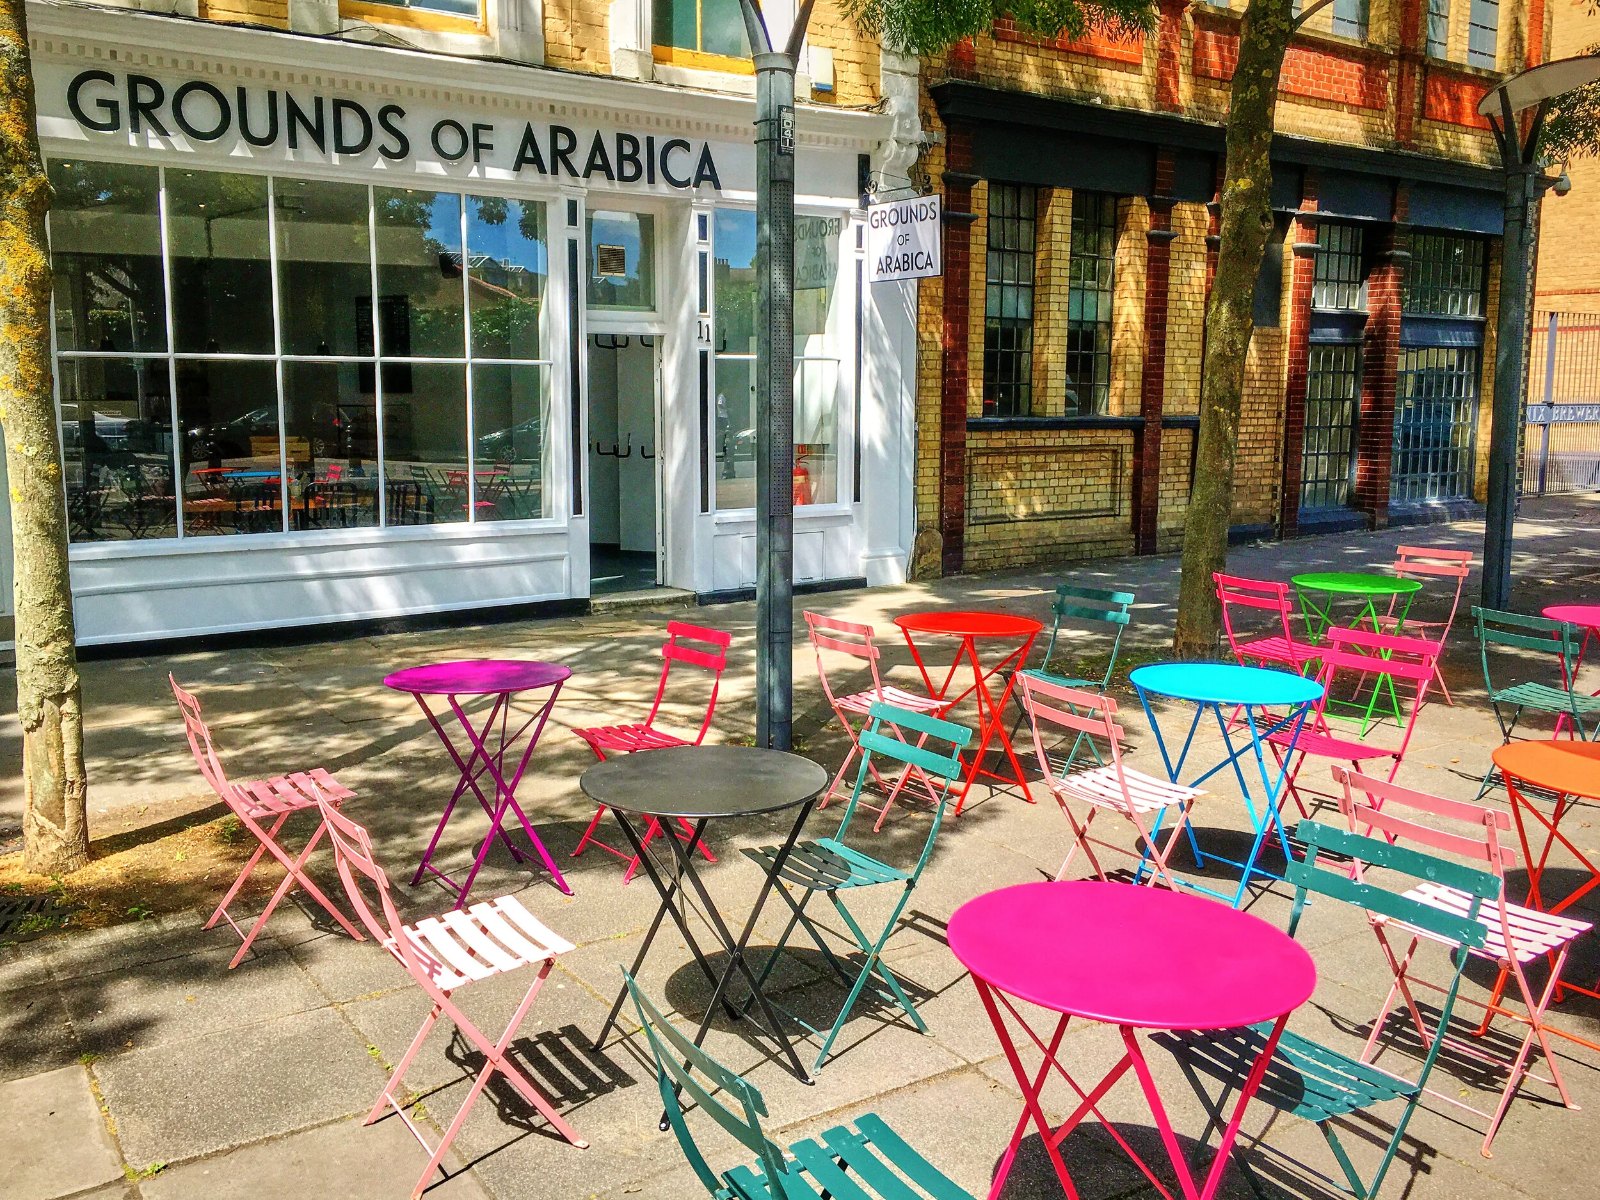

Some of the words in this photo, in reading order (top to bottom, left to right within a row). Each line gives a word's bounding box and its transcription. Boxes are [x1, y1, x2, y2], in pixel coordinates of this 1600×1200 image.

[67, 70, 410, 160] GROUNDS
[431, 119, 493, 162] OF
[512, 121, 722, 190] ARABICA
[870, 201, 937, 229] GROUNDS
[896, 233, 910, 246] OF
[876, 251, 934, 275] ARABICA
[697, 320, 711, 342] 11
